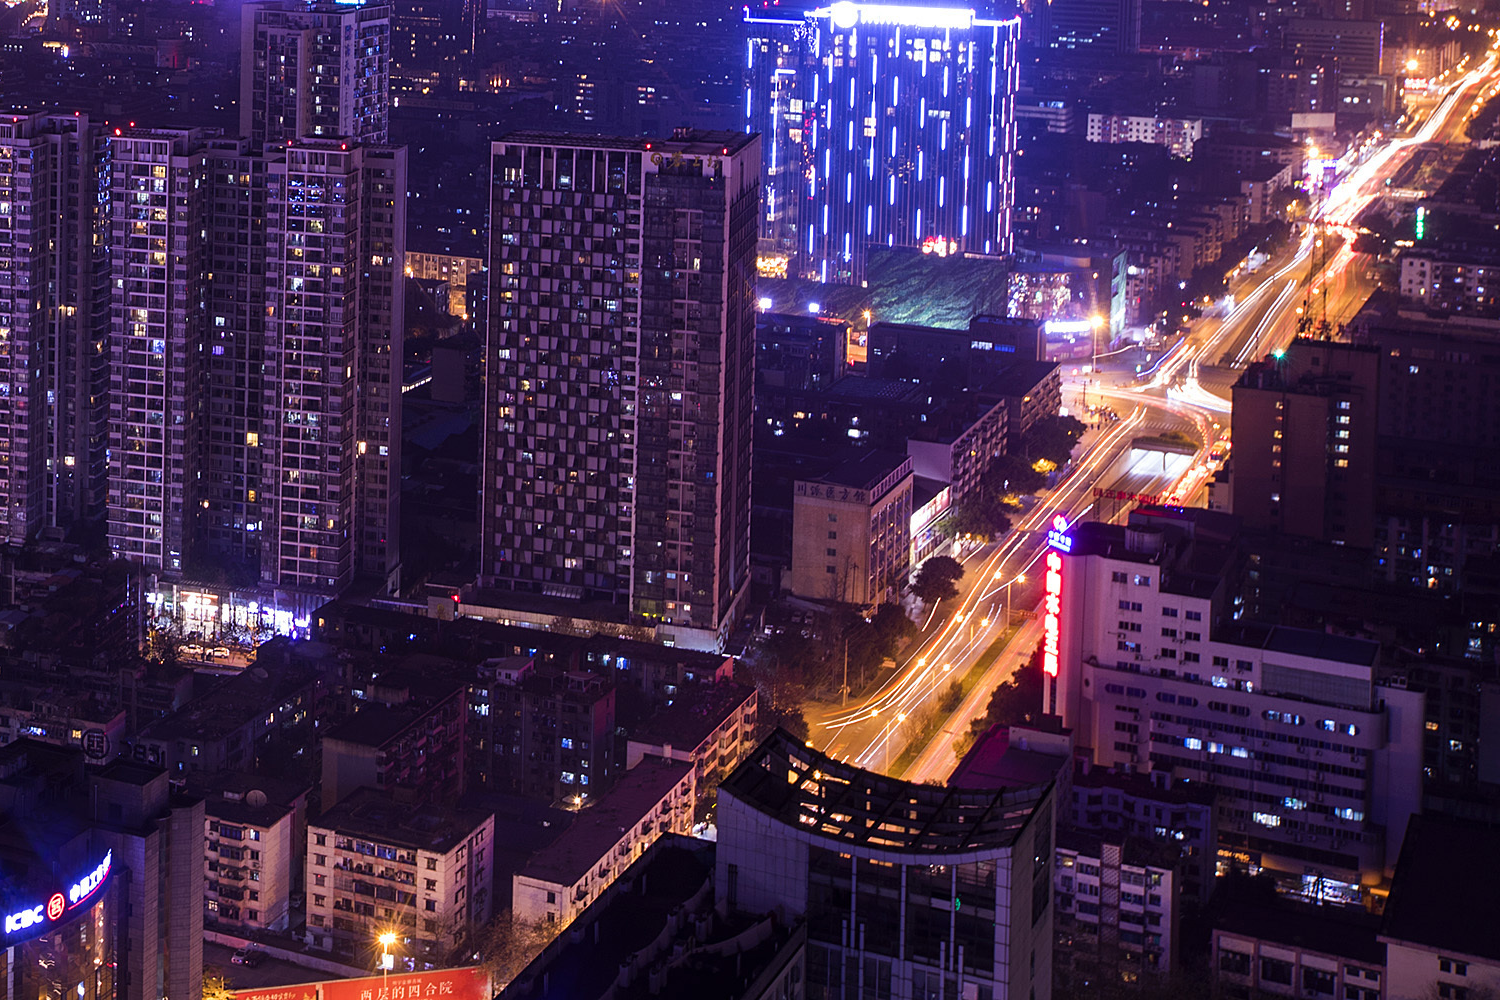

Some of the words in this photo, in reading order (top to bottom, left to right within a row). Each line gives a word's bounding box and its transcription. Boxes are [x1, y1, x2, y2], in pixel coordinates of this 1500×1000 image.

[5, 904, 44, 934] ICBC
[360, 981, 453, 1000] 两层的四合院
